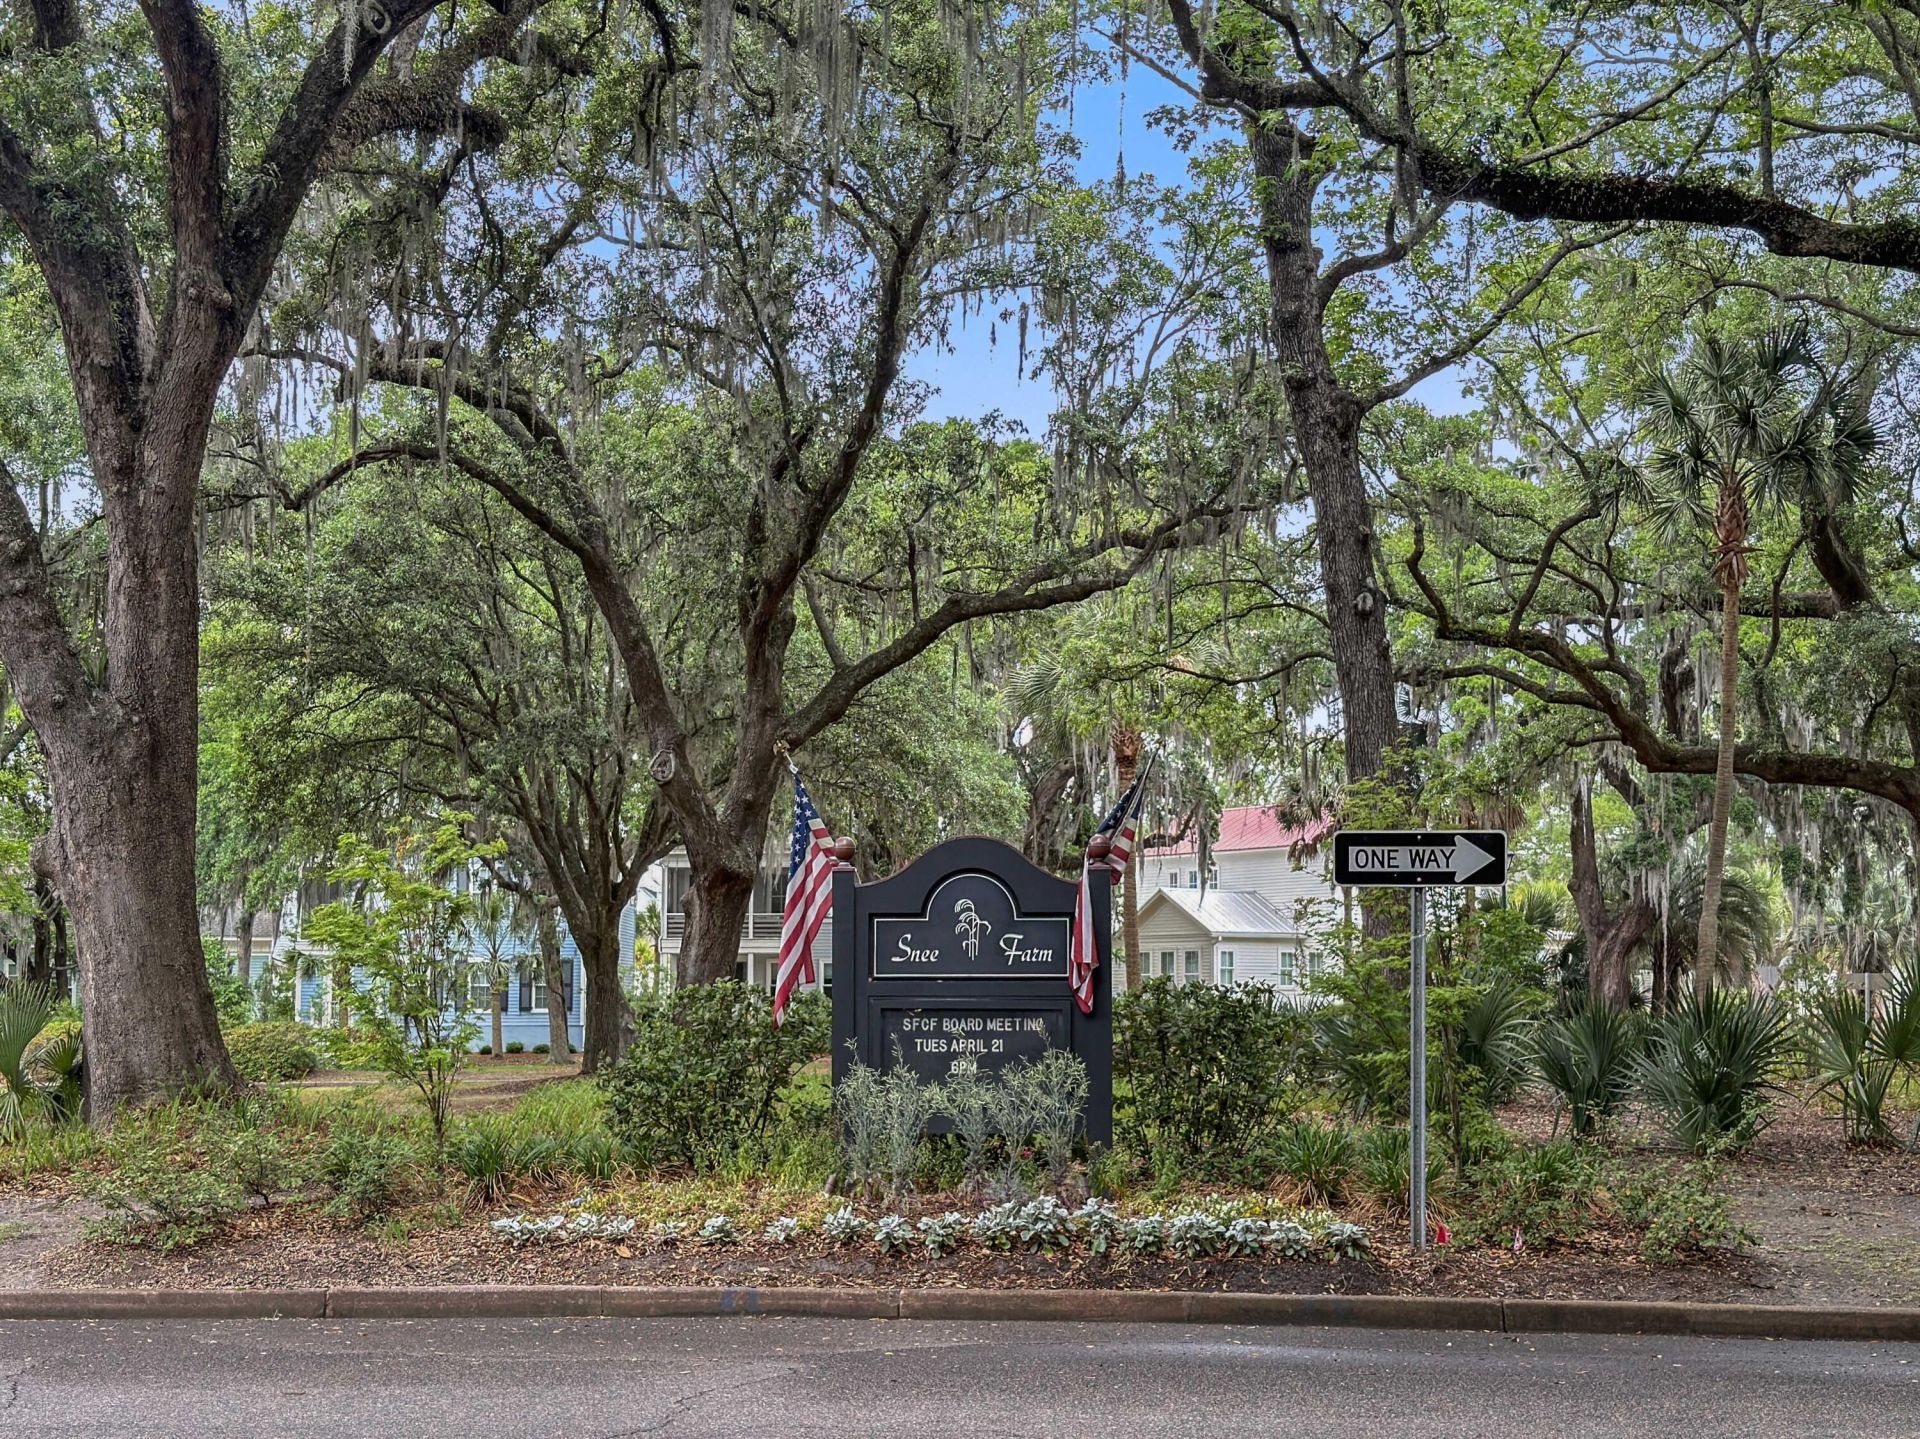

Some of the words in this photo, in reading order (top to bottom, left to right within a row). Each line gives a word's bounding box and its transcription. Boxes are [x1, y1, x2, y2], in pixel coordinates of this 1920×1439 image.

[1355, 849, 1399, 869] ONE
[1409, 849, 1456, 869] WAY
[891, 933, 939, 962] Snee
[1000, 933, 1053, 965] Farm
[902, 1018, 938, 1031] SFCF
[942, 1018, 983, 1031] BOARD
[914, 1039, 948, 1052] TUES
[950, 1039, 988, 1052] APRIL
[991, 1039, 1004, 1052] 21
[951, 1061, 977, 1074] 6PM
